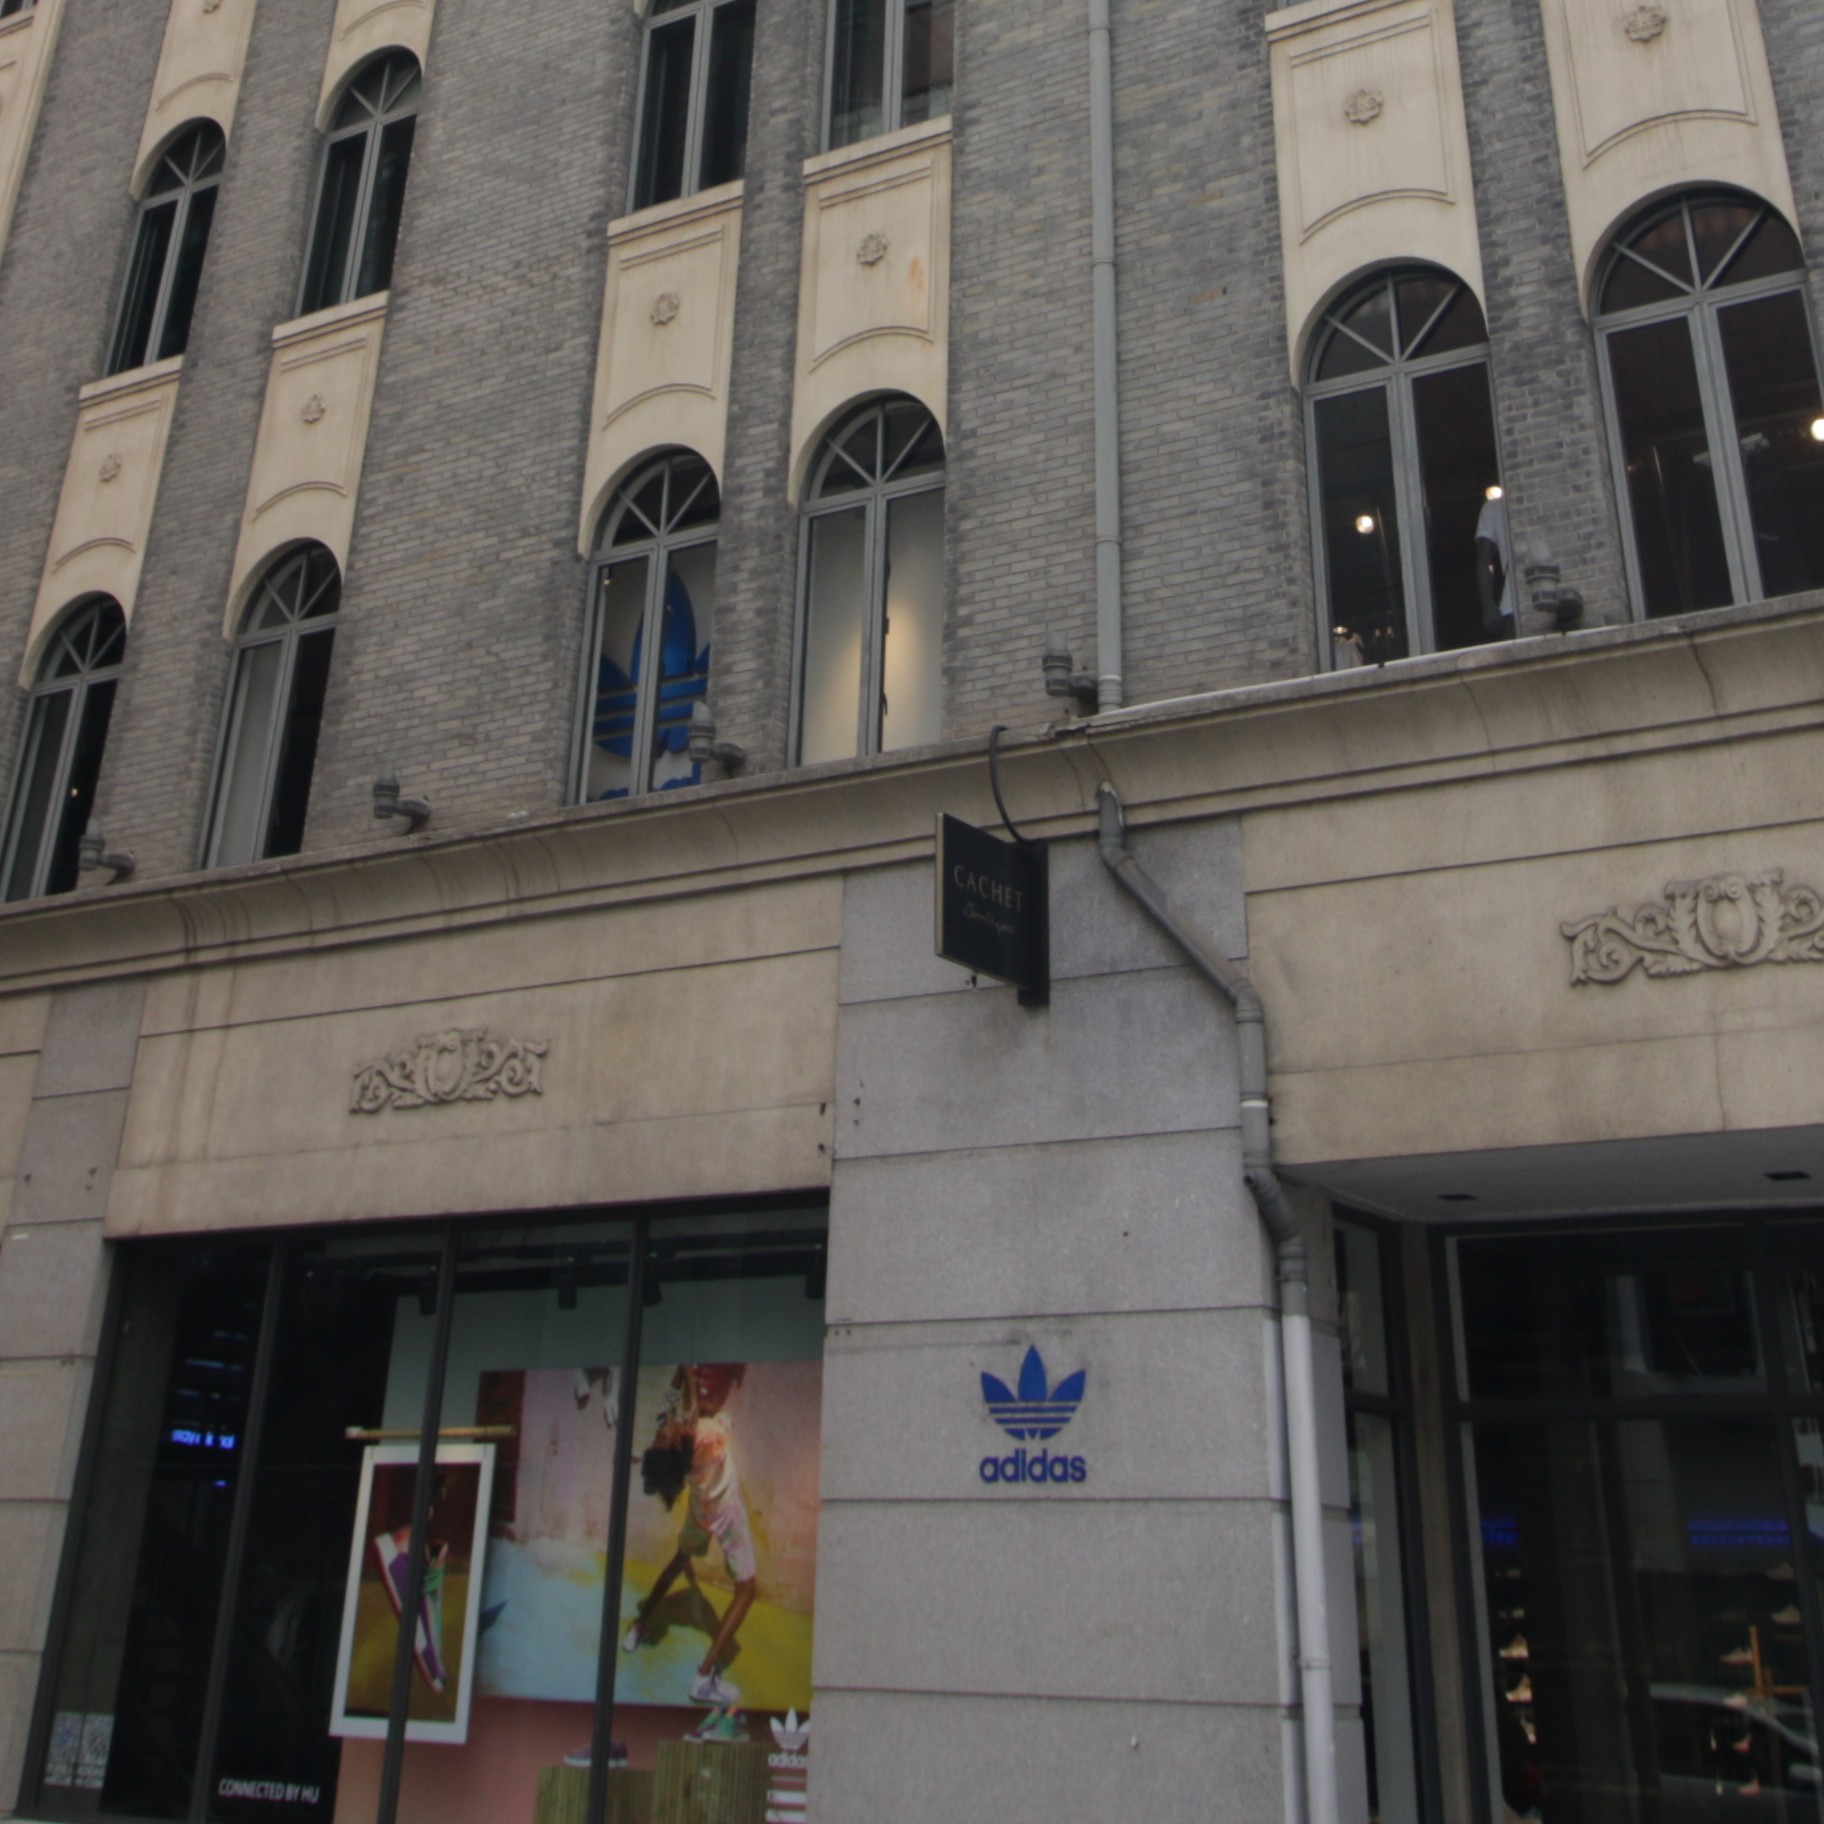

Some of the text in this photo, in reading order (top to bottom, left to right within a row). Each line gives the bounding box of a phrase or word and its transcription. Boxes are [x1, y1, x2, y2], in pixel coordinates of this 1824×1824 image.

[953, 863, 1024, 913] CACHET
[979, 1447, 1087, 1483] adidas
[218, 1777, 285, 1802] CONNECTED
[285, 1782, 301, 1803] BY
